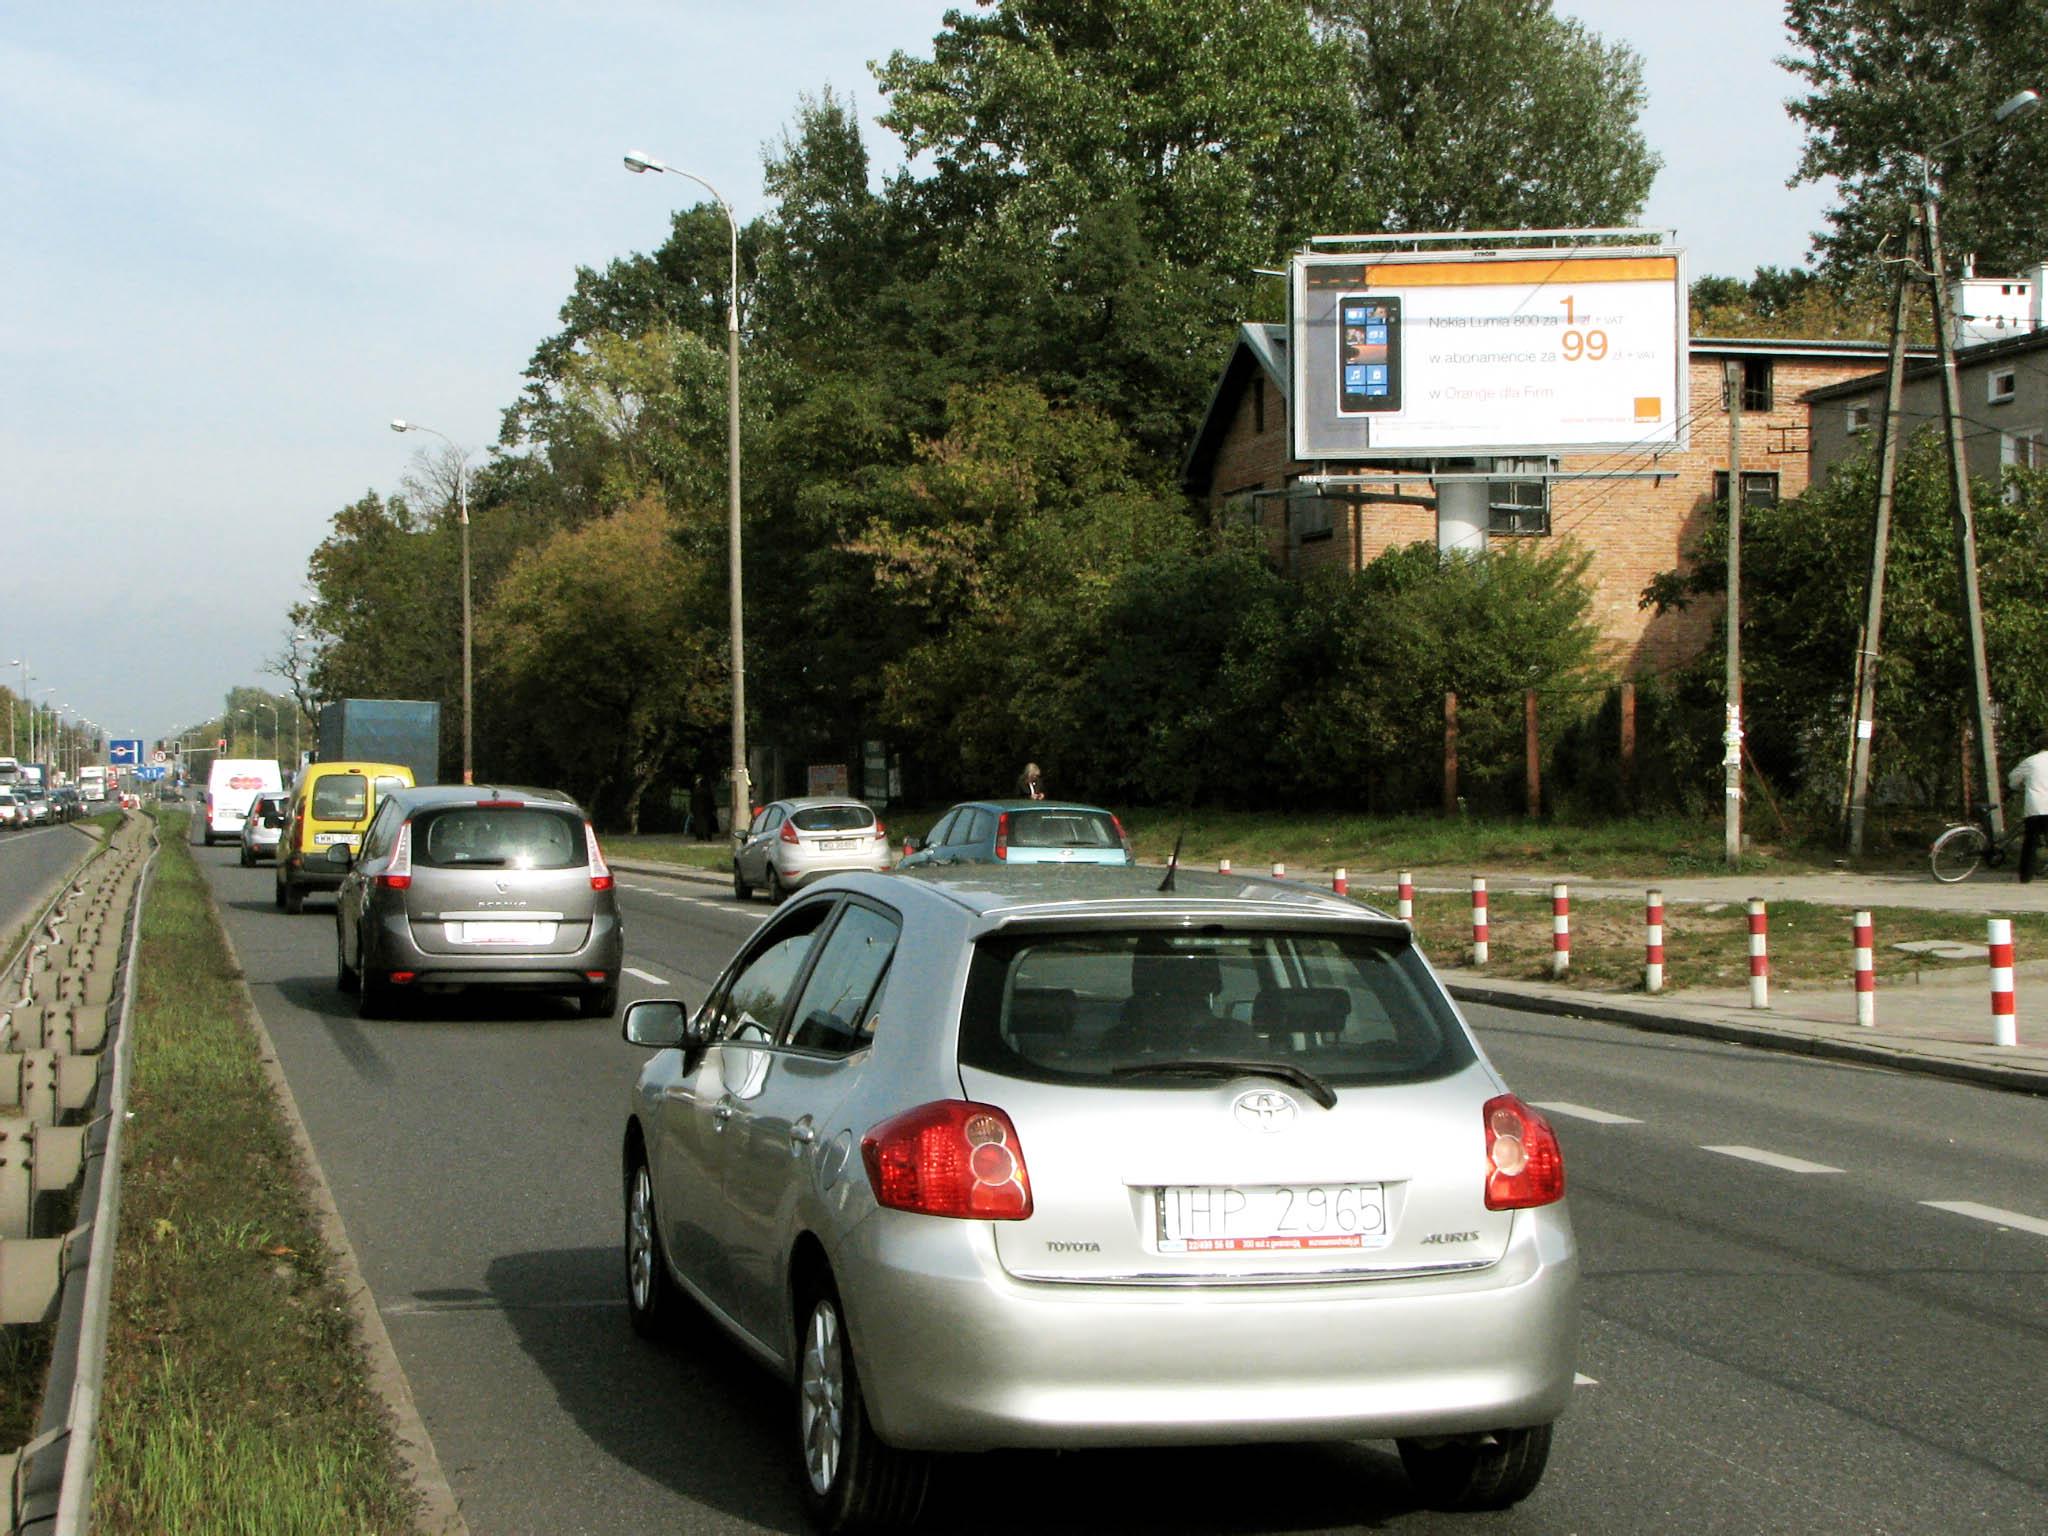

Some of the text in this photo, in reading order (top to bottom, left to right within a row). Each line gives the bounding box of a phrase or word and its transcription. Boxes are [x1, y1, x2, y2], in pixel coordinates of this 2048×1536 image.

[1428, 315, 1467, 328] Nokia
[1469, 315, 1510, 327] Lumia
[1512, 314, 1539, 327] 800
[1542, 316, 1558, 326] za
[1559, 294, 1575, 325] 1
[1429, 353, 1441, 363] w
[1444, 349, 1537, 363] abonamencie
[1540, 352, 1556, 362] za
[1561, 329, 1609, 361] 99
[1429, 384, 1554, 404] w Orange dla Firm
[1275, 1188, 1383, 1233] 2965
[1047, 1241, 1101, 1252] TOYOTA
[1419, 1230, 1480, 1245] AURIS
